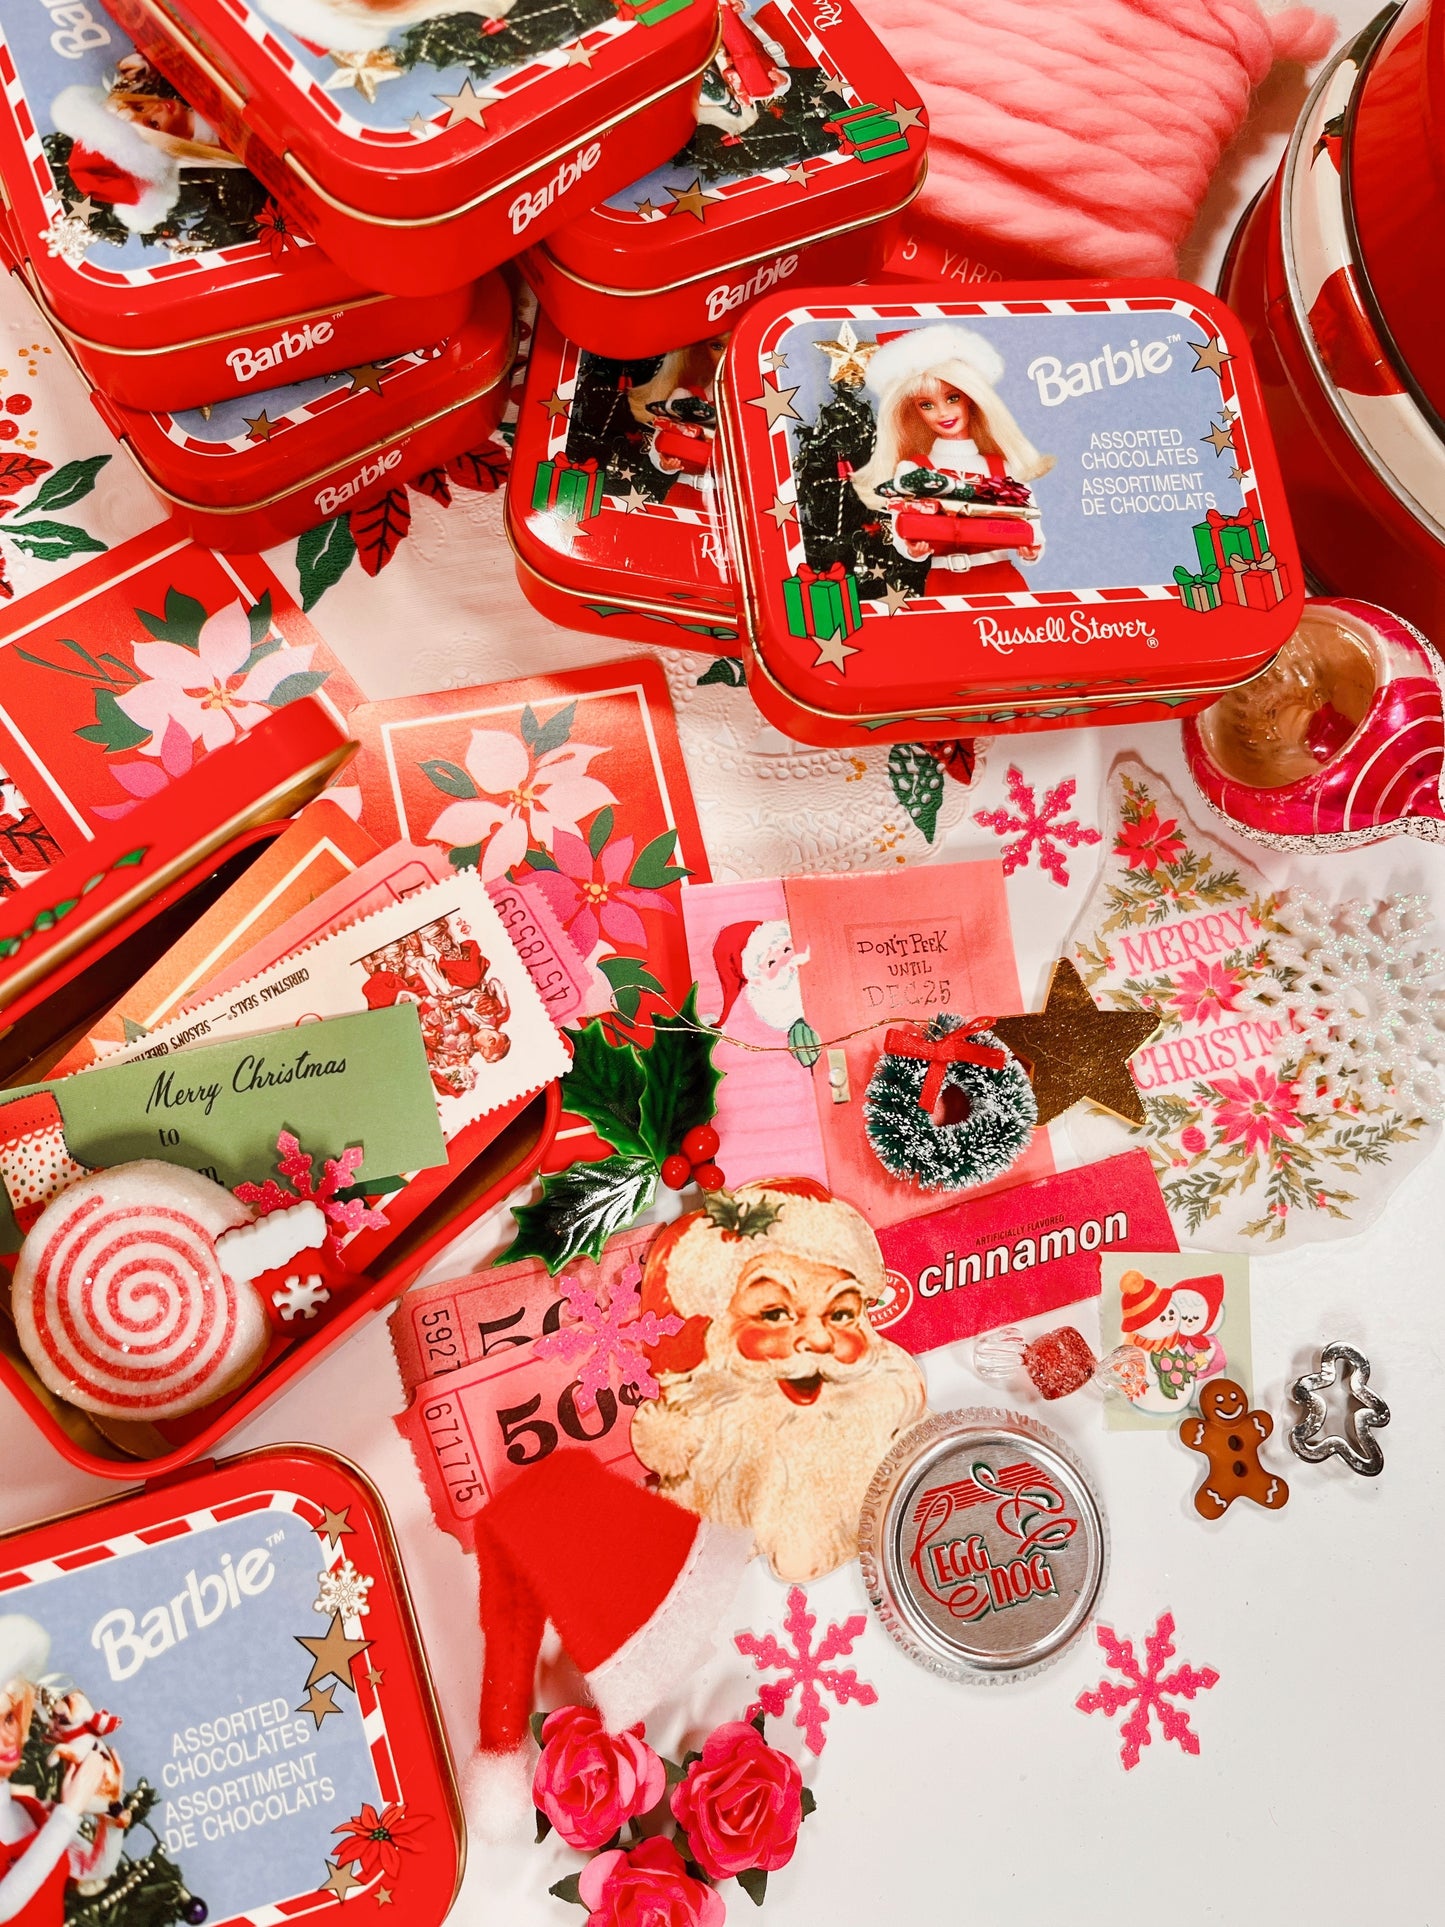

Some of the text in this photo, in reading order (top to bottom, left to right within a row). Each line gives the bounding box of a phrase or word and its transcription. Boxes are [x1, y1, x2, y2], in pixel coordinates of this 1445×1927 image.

[941, 249, 1016, 284] YARD
[1090, 428, 1183, 450] ASSORTED
[1081, 448, 1199, 470] CHOCOLATES
[1082, 472, 1204, 497] ASSORTIMENT
[1081, 492, 1217, 516] DE CHOCOLATS
[973, 616, 1070, 655] Russell
[1119, 907, 1252, 977] MERRY
[260, 968, 310, 1002] CHRISTMAS
[887, 960, 932, 976] UNTIL
[170, 1019, 211, 1050] SEASON'S
[146, 1050, 346, 1115] Merry Christmas
[159, 1128, 180, 1147] to
[976, 1215, 1064, 1246] ARTIFICIALLY FLAVORED
[918, 1210, 1128, 1299] cinnamon
[425, 1402, 485, 1504] 671775
[933, 1536, 989, 1583] EGG
[172, 1698, 289, 1758] ASSORTED
[162, 1718, 311, 1789] CHOCOLATES
[165, 1752, 318, 1827] ASSORTIMENT
[165, 1776, 336, 1854] DE CHOCOLATS
